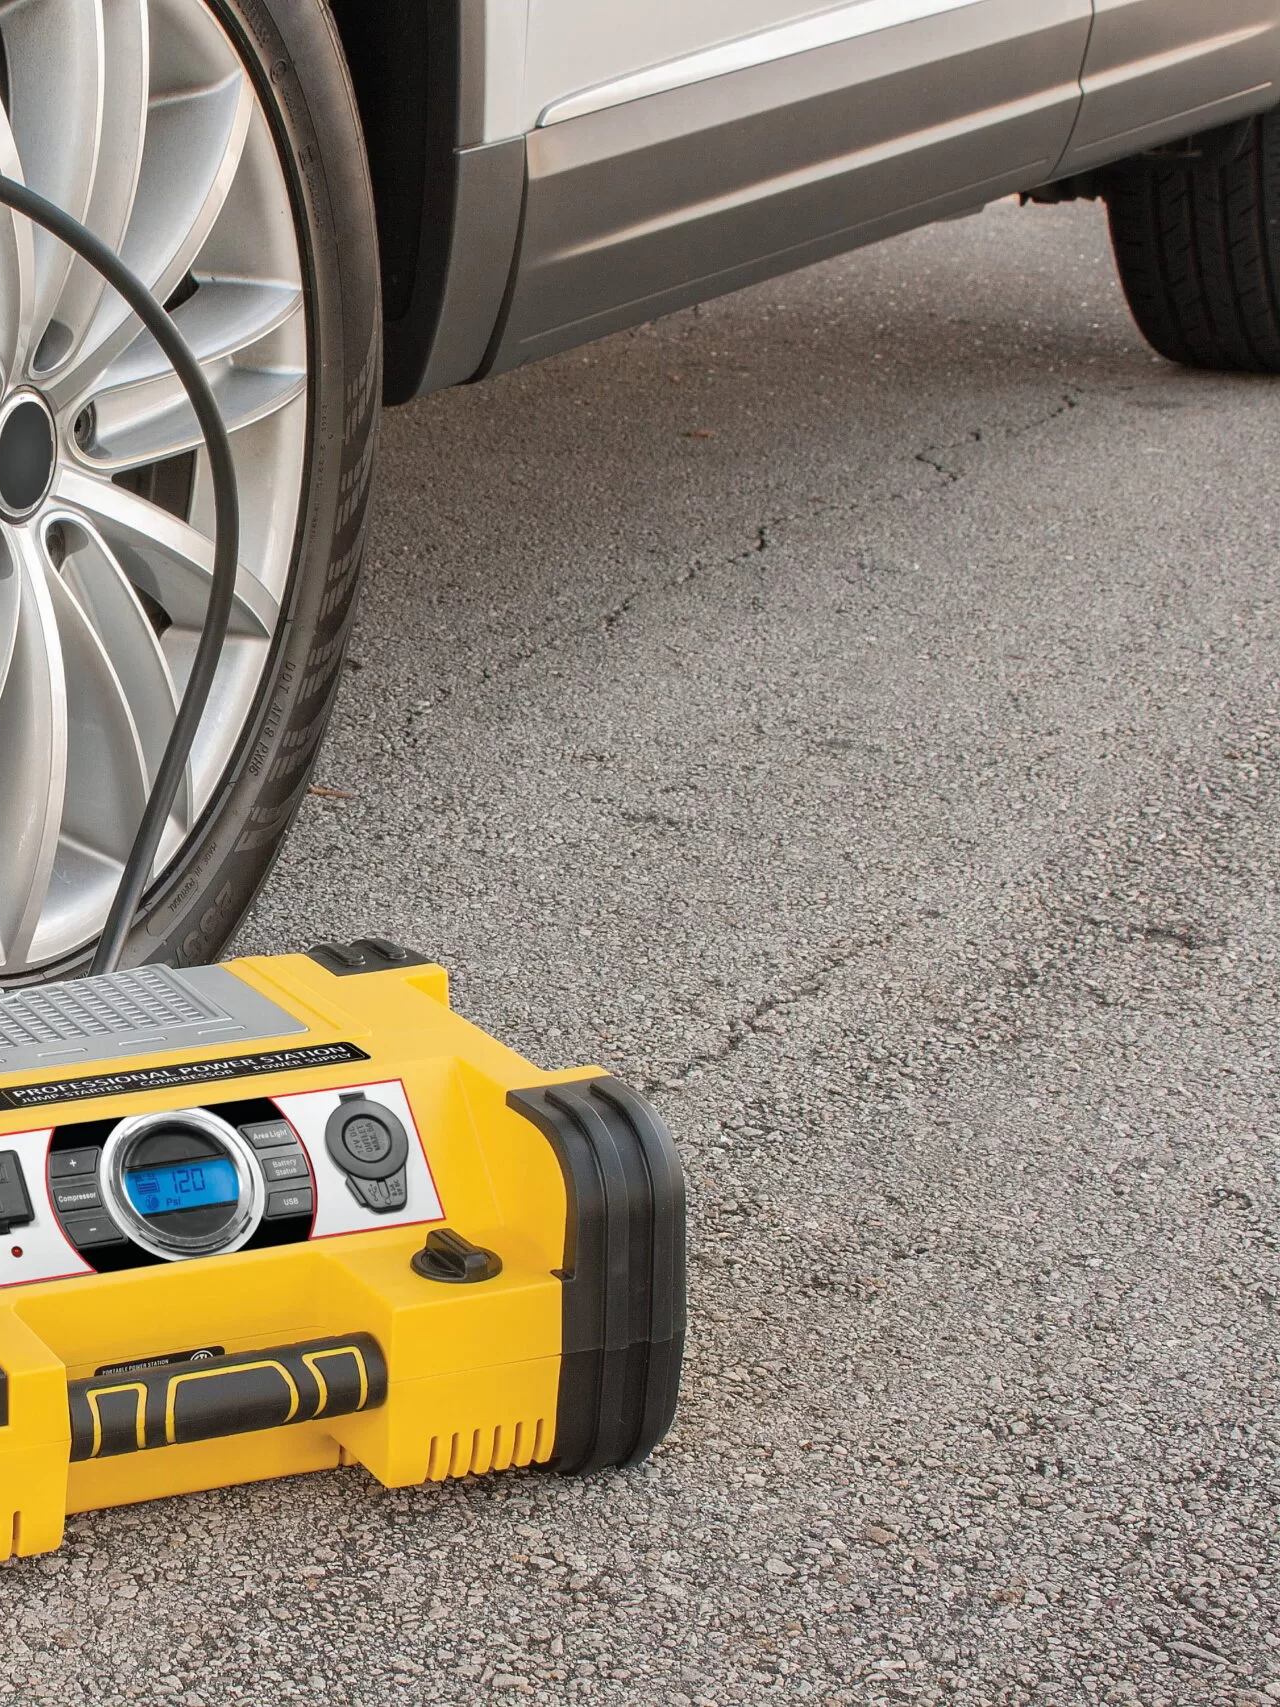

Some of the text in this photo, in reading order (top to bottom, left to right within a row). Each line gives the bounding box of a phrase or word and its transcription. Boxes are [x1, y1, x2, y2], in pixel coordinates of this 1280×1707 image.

[12, 1045, 348, 1098] PROFESSIONAL POWER STATION
[21, 1053, 352, 1104] JUMP-STARTER COMPRESSOR POWER SUPPLY
[253, 1129, 288, 1140] Area Light
[356, 1125, 373, 1153] OUTLET
[272, 1159, 297, 1168] Battery
[275, 1167, 297, 1176] Status
[172, 1168, 206, 1194] 120
[58, 1191, 96, 1203] Compressor
[166, 1196, 182, 1207] Psi
[283, 1197, 299, 1206] USB
[147, 1359, 169, 1368] STATION
